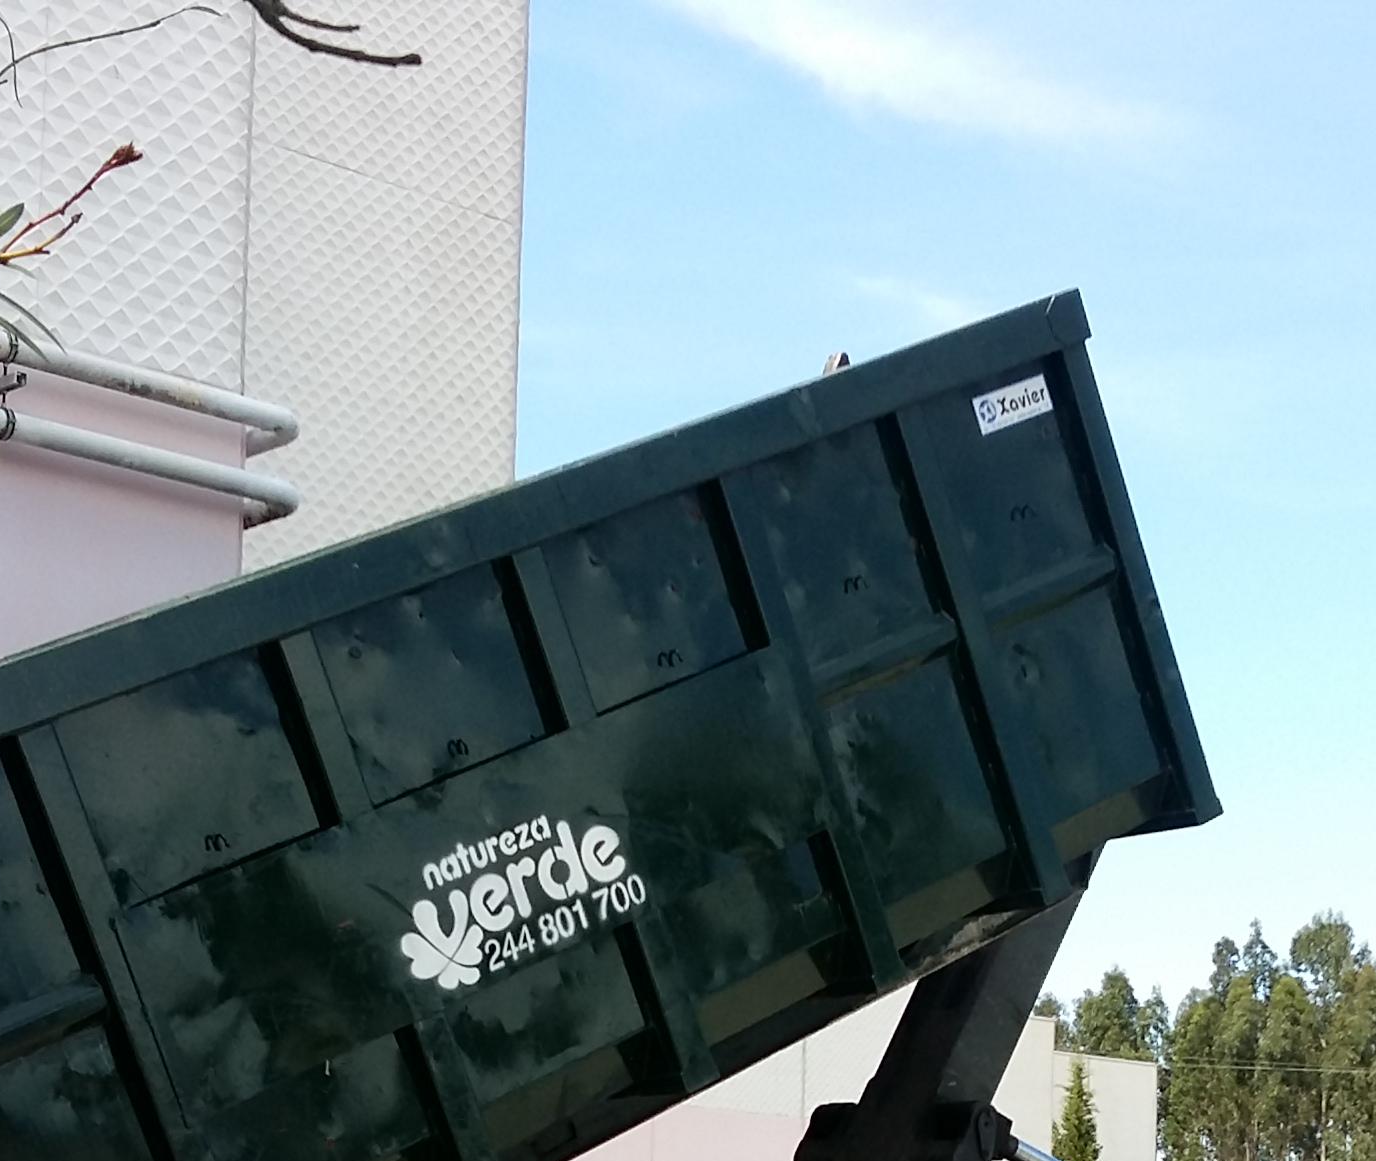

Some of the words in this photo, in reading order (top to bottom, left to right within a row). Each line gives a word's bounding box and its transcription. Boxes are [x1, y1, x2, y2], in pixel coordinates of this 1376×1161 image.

[997, 388, 1046, 415] Xavier
[409, 820, 626, 957] verde
[423, 814, 552, 890] natureza
[484, 923, 535, 972] 244
[538, 898, 589, 946] 801
[591, 873, 647, 922] 700
